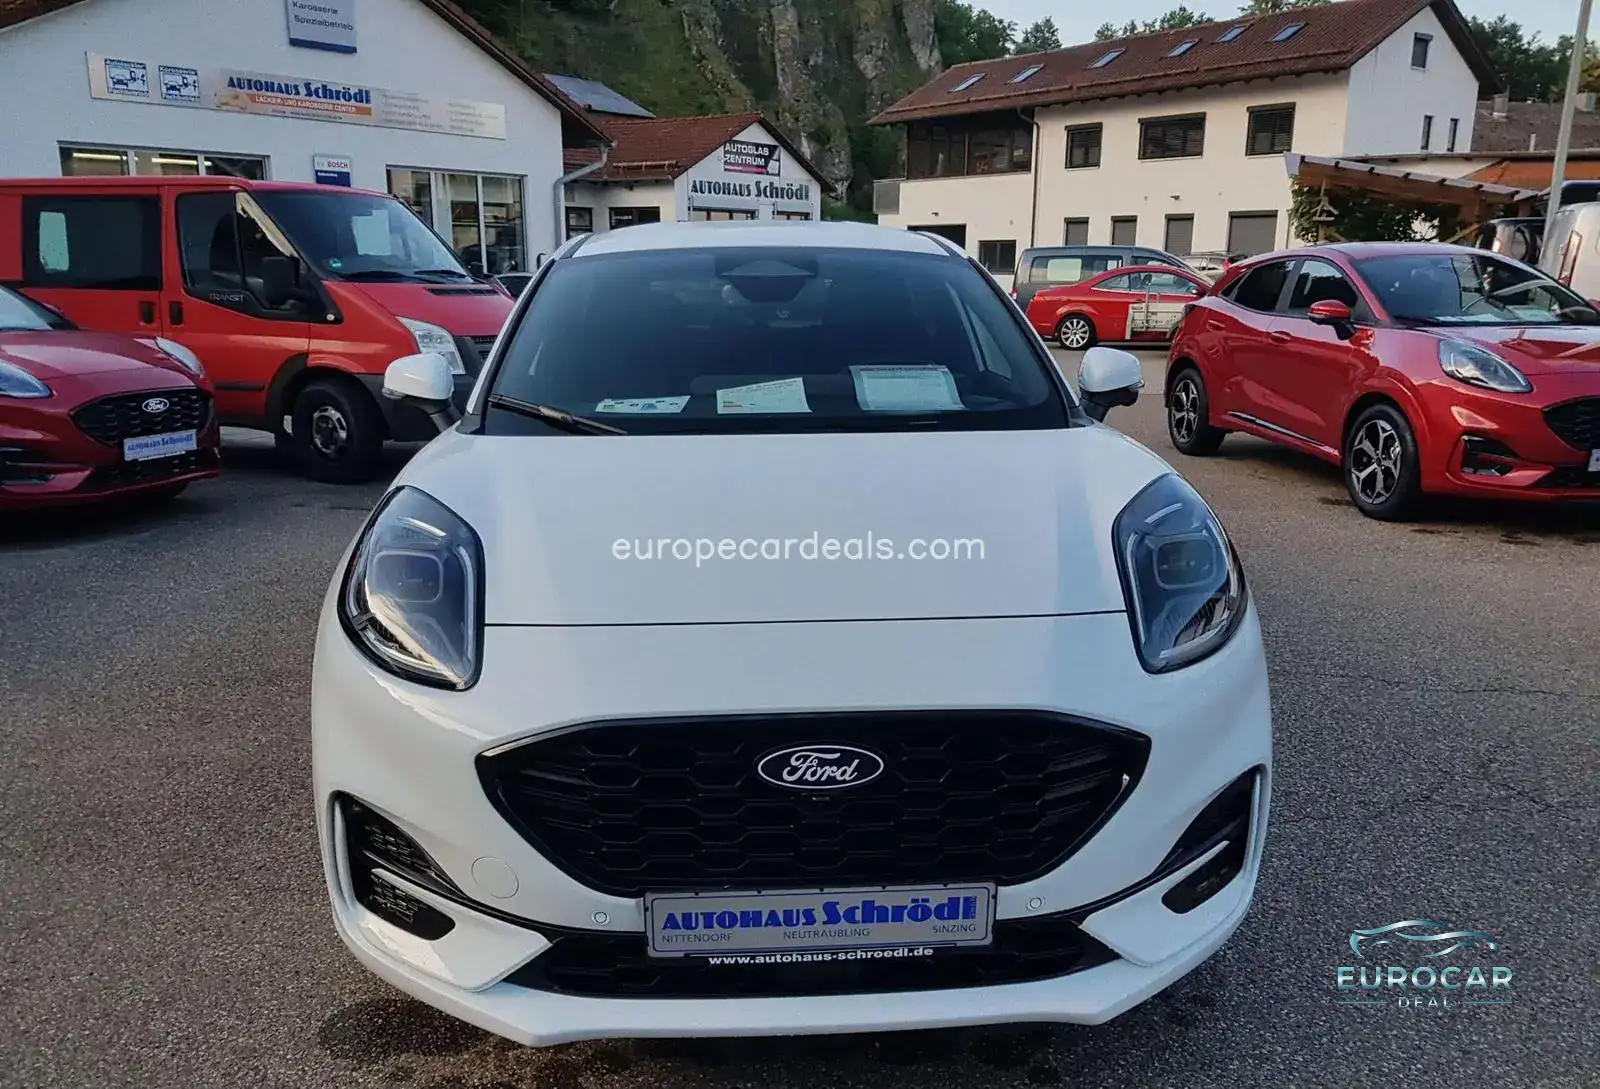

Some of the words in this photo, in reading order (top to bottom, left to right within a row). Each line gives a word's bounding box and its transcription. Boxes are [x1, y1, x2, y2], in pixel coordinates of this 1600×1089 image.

[292, 1, 338, 14] Karosserie
[294, 15, 354, 31] Spezialbetrieb
[227, 76, 300, 96] AUTOHAUS
[303, 82, 372, 104] Schrödl
[334, 105, 357, 113] CENTER
[725, 143, 769, 156] AUTOGLAS
[327, 161, 348, 169] BOSCH
[724, 153, 765, 166] ZENTRUM
[690, 179, 752, 197] AUTOHAUS
[754, 180, 810, 201] Schrödl
[782, 751, 859, 783] Ford
[662, 908, 817, 931] AUTOHAUS
[822, 896, 977, 925] Schrödl
[662, 932, 733, 943] NITTENDORF
[783, 927, 870, 941] NEUTRAUBLING
[933, 924, 976, 934] SINZING
[708, 946, 934, 965] www.autohaus-schroedl.de
